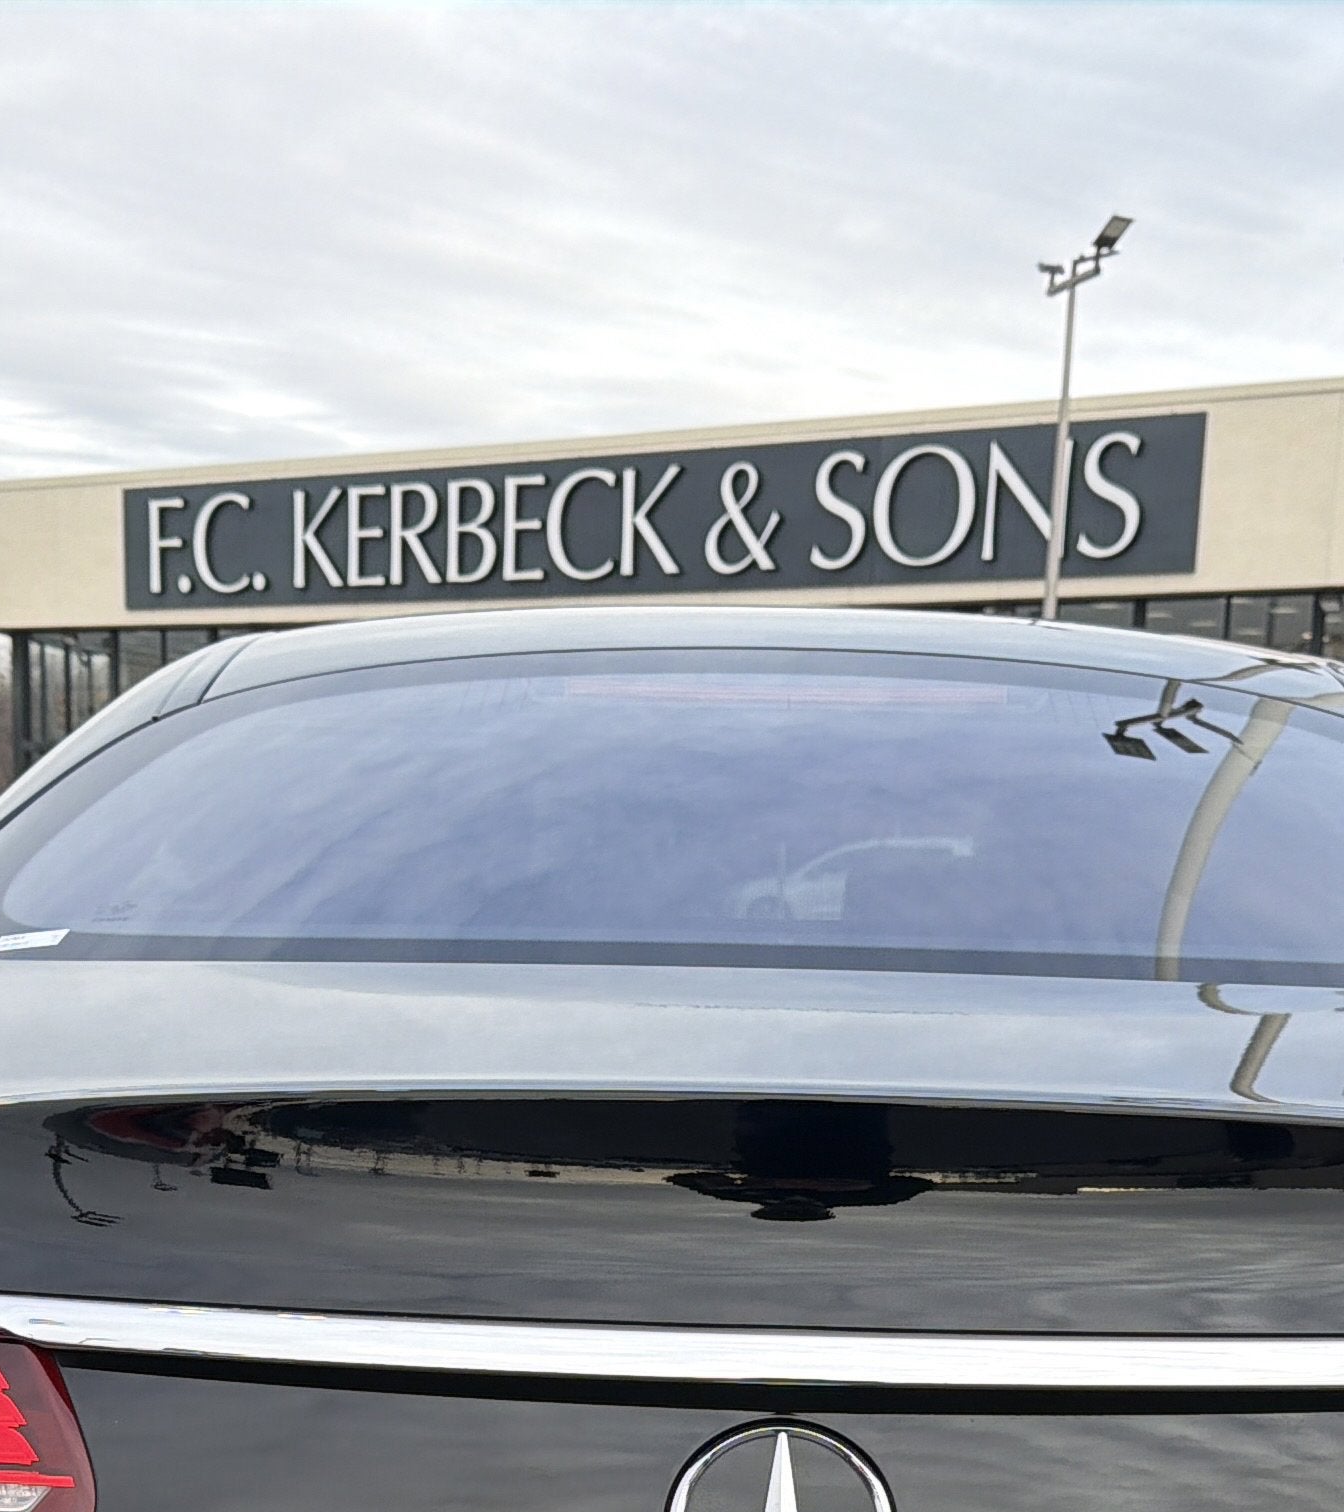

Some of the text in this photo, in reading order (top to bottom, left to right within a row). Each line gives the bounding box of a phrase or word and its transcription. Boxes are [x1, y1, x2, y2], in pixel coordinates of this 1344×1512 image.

[148, 431, 1143, 594] F.C. KERBECK & SONS
